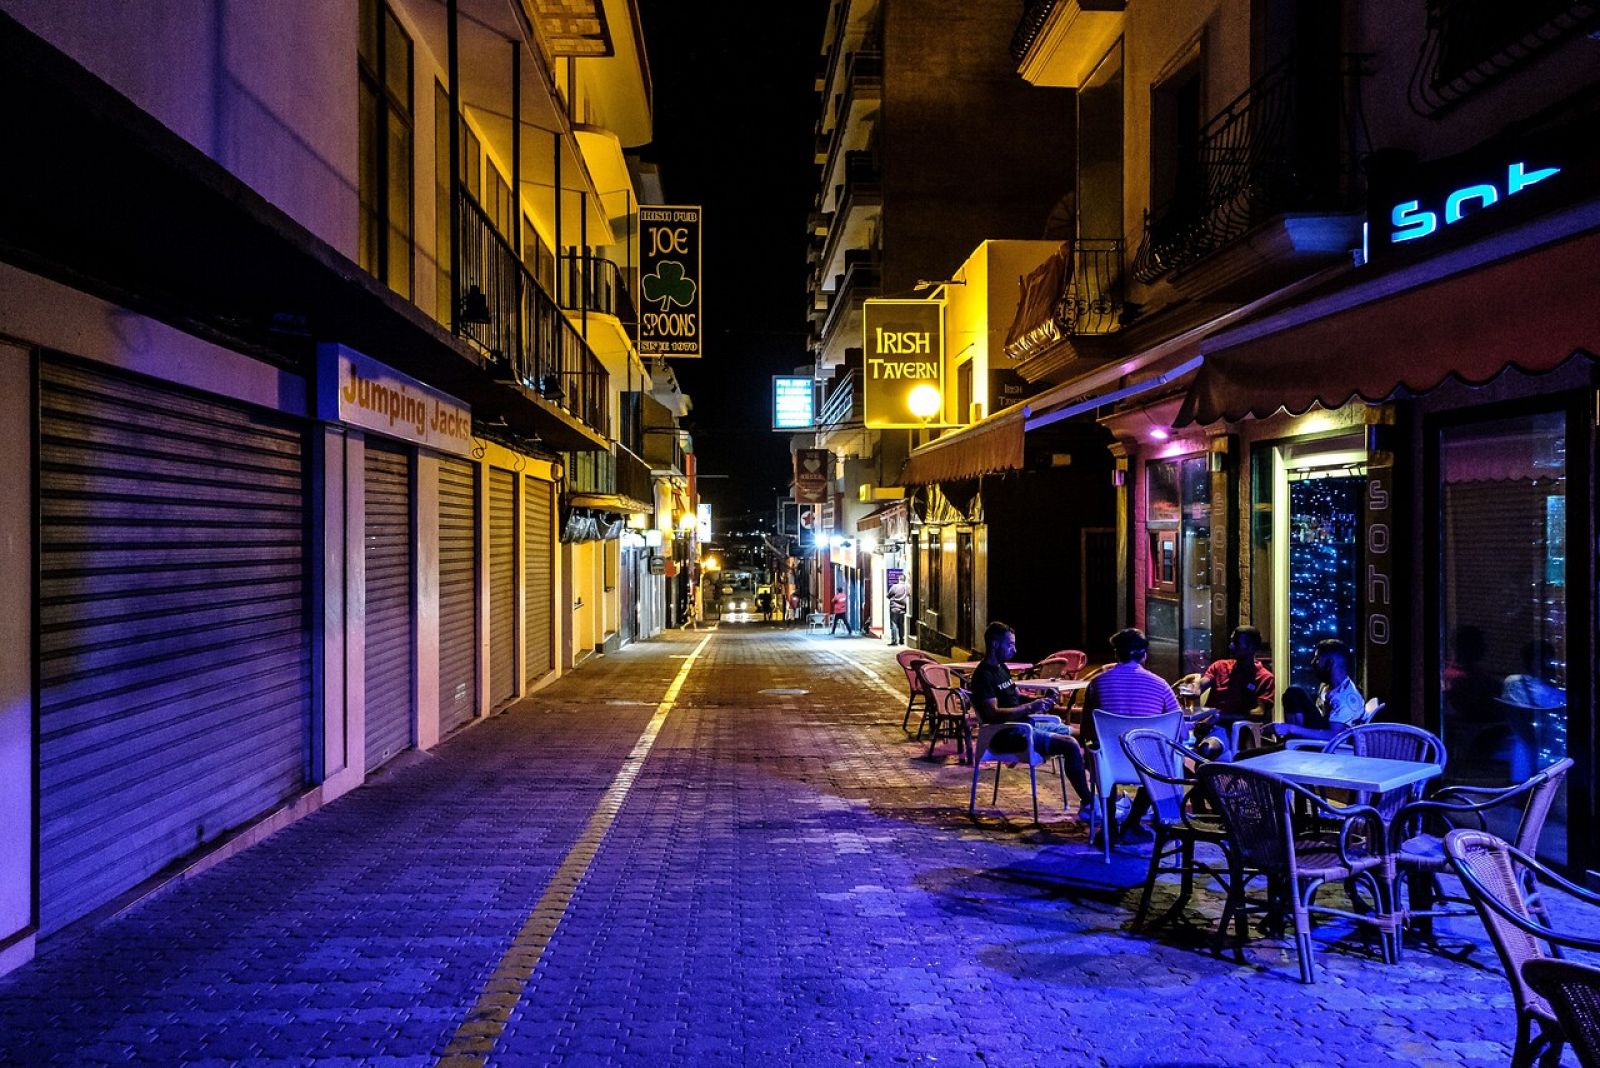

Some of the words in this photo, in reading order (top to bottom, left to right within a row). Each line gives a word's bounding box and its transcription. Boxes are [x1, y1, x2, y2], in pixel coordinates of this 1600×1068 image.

[641, 210, 671, 221] IRISH
[674, 210, 697, 221] PUB
[649, 227, 689, 257] JOE
[643, 313, 696, 337] SPOONS
[876, 327, 930, 354] IRISH
[868, 358, 938, 379] TAVERN
[343, 363, 426, 436] Jumping
[430, 399, 469, 441] Jacks
[1368, 479, 1391, 645] soho
